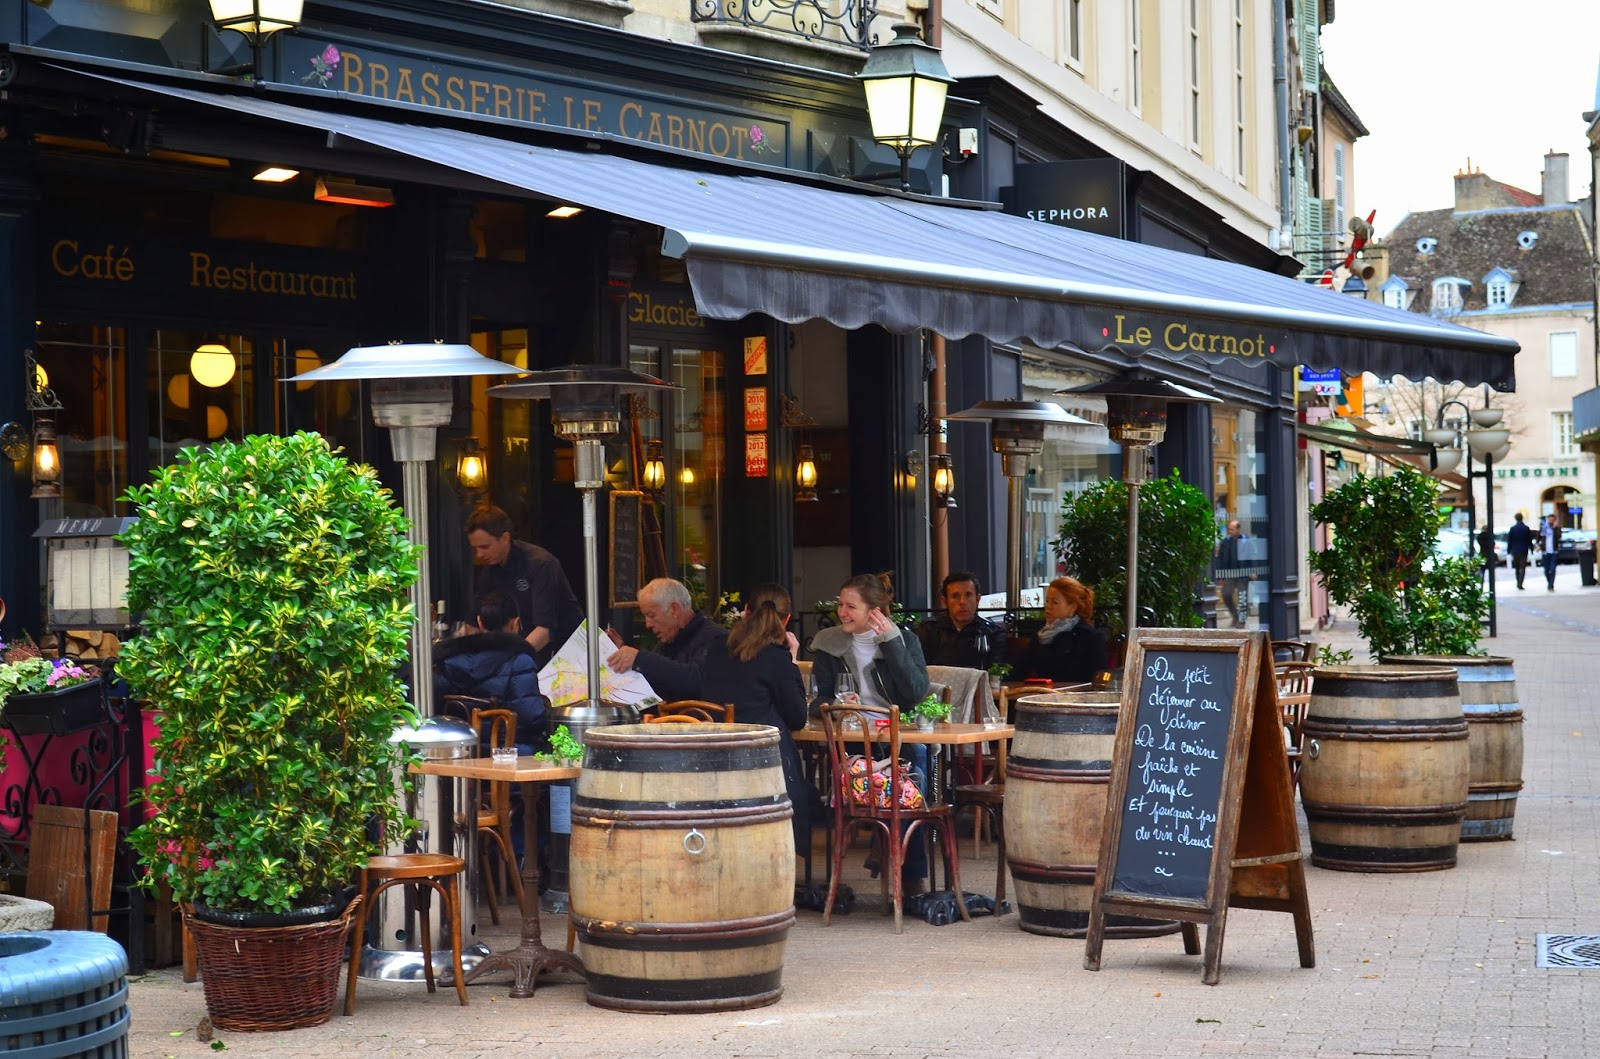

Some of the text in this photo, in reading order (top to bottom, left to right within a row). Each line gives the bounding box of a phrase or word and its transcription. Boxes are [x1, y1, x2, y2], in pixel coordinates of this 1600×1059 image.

[341, 52, 748, 160] BRASSERIE LE CARNOT
[1026, 206, 1109, 221] SEPHORA
[51, 239, 357, 300] Café Restaurant
[1114, 314, 1265, 357] Le Carnot
[747, 395, 765, 404] 2010
[748, 441, 764, 450] 2012
[1497, 467, 1579, 478] URGOGNE
[55, 519, 103, 534] MENU
[1146, 656, 1212, 693] Du petit
[1200, 699, 1221, 711] au
[1165, 710, 1206, 730] dîner
[1135, 724, 1218, 759] De la cuisine
[1138, 751, 1200, 784] fraîche et
[1146, 779, 1193, 803] simple
[1129, 795, 1216, 830] Et pourquoi pas
[1135, 825, 1213, 848] du vin chaud
